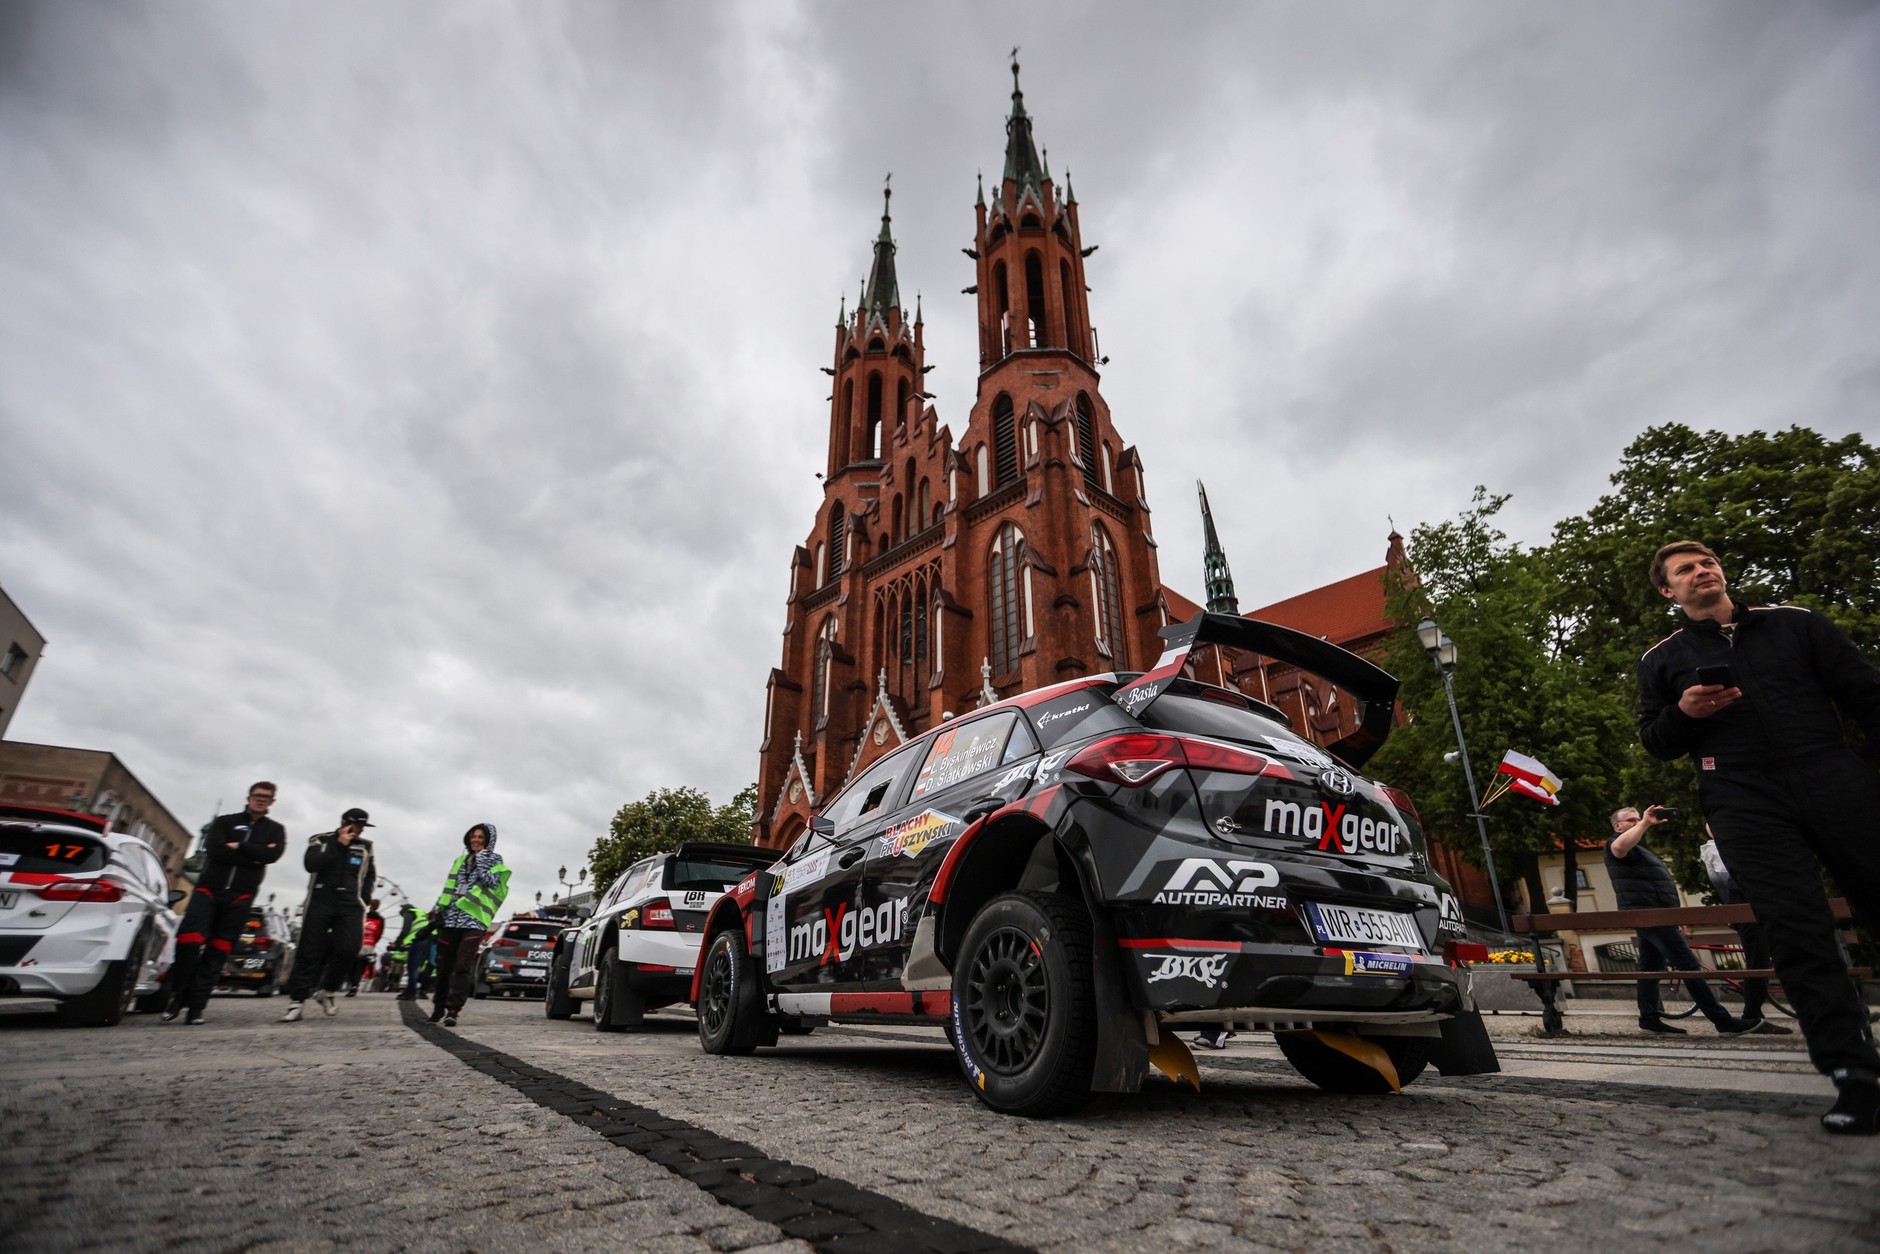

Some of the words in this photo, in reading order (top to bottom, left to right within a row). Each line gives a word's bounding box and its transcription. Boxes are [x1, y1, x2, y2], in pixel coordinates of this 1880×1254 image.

[1127, 682, 1158, 706] Basia
[926, 777, 934, 791] D.
[937, 751, 993, 787] Siatkowski
[885, 811, 931, 839] BLACHY
[45, 843, 85, 859] 17
[880, 821, 953, 858] PRUSZYŃSKI
[737, 876, 756, 895] TEKOM
[1163, 858, 1280, 893] AP
[1152, 892, 1287, 909] AUTOPARTNER
[1317, 925, 1327, 935] PL
[1320, 908, 1357, 939] WR
[1358, 911, 1417, 945] 555AW
[1366, 959, 1408, 971] MICHELIN
